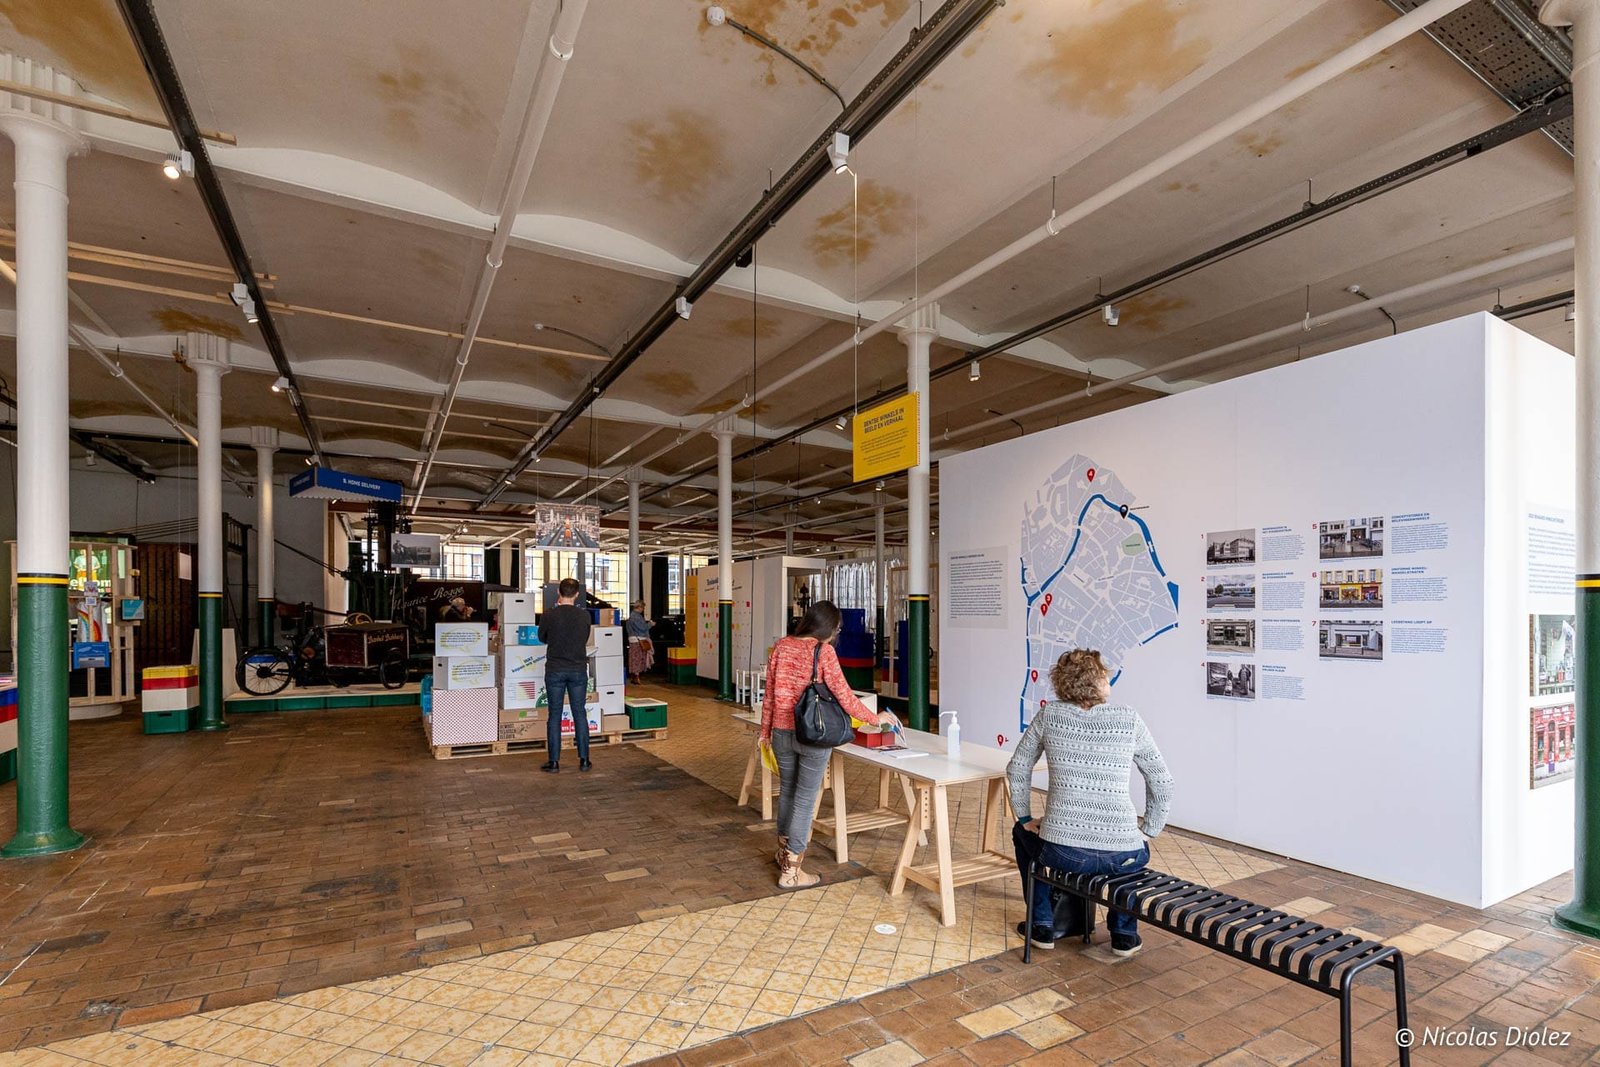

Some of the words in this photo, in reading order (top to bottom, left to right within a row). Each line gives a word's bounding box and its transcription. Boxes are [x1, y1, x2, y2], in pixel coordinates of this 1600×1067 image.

[880, 408, 898, 421] WINKELS
[884, 415, 904, 426] VERHAAL
[347, 479, 361, 487] HOME
[361, 481, 381, 491] DELIVERY
